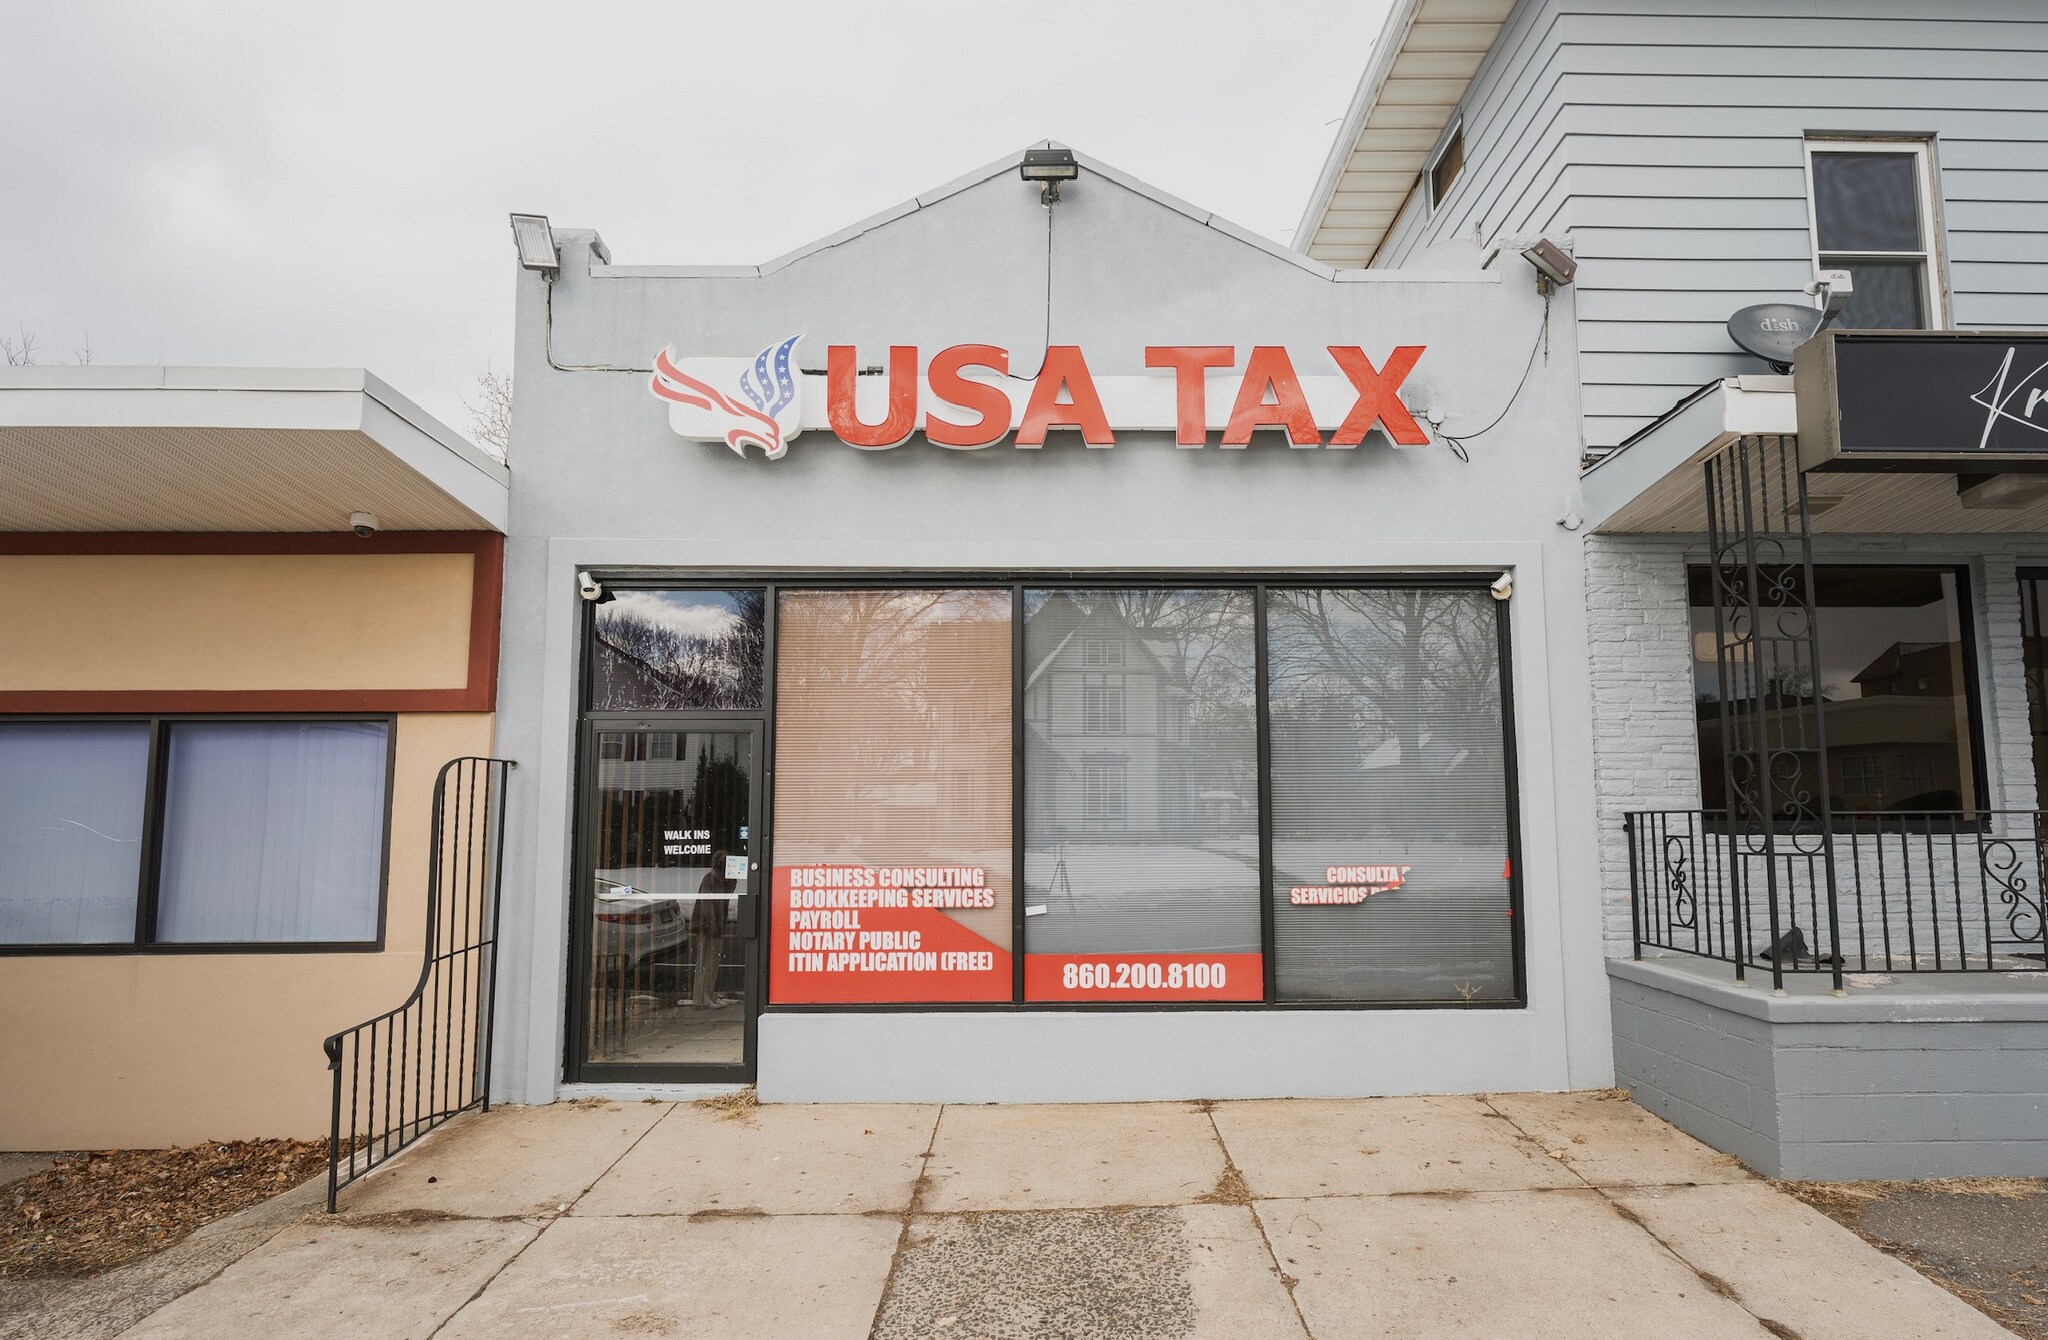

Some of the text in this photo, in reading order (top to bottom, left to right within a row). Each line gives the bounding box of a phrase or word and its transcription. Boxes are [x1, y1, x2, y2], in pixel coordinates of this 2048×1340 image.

[1760, 318, 1800, 331] dish
[827, 344, 1430, 450] USA TAX
[664, 830, 711, 840] WALK INS
[664, 844, 711, 855] WELCOME
[790, 868, 984, 887] BUSINESS CONSULTING
[1326, 866, 1399, 883] CONSULTA
[790, 888, 994, 908] BOOKKEEPING SERVICES
[1291, 887, 1367, 904] SERVICIOS
[790, 910, 861, 929] PAYROLL
[789, 931, 921, 950] NOTARY PUBLIC
[788, 951, 993, 972] ITIN APPLICATION (FREE)
[1063, 963, 1226, 989] 860.200.8100
